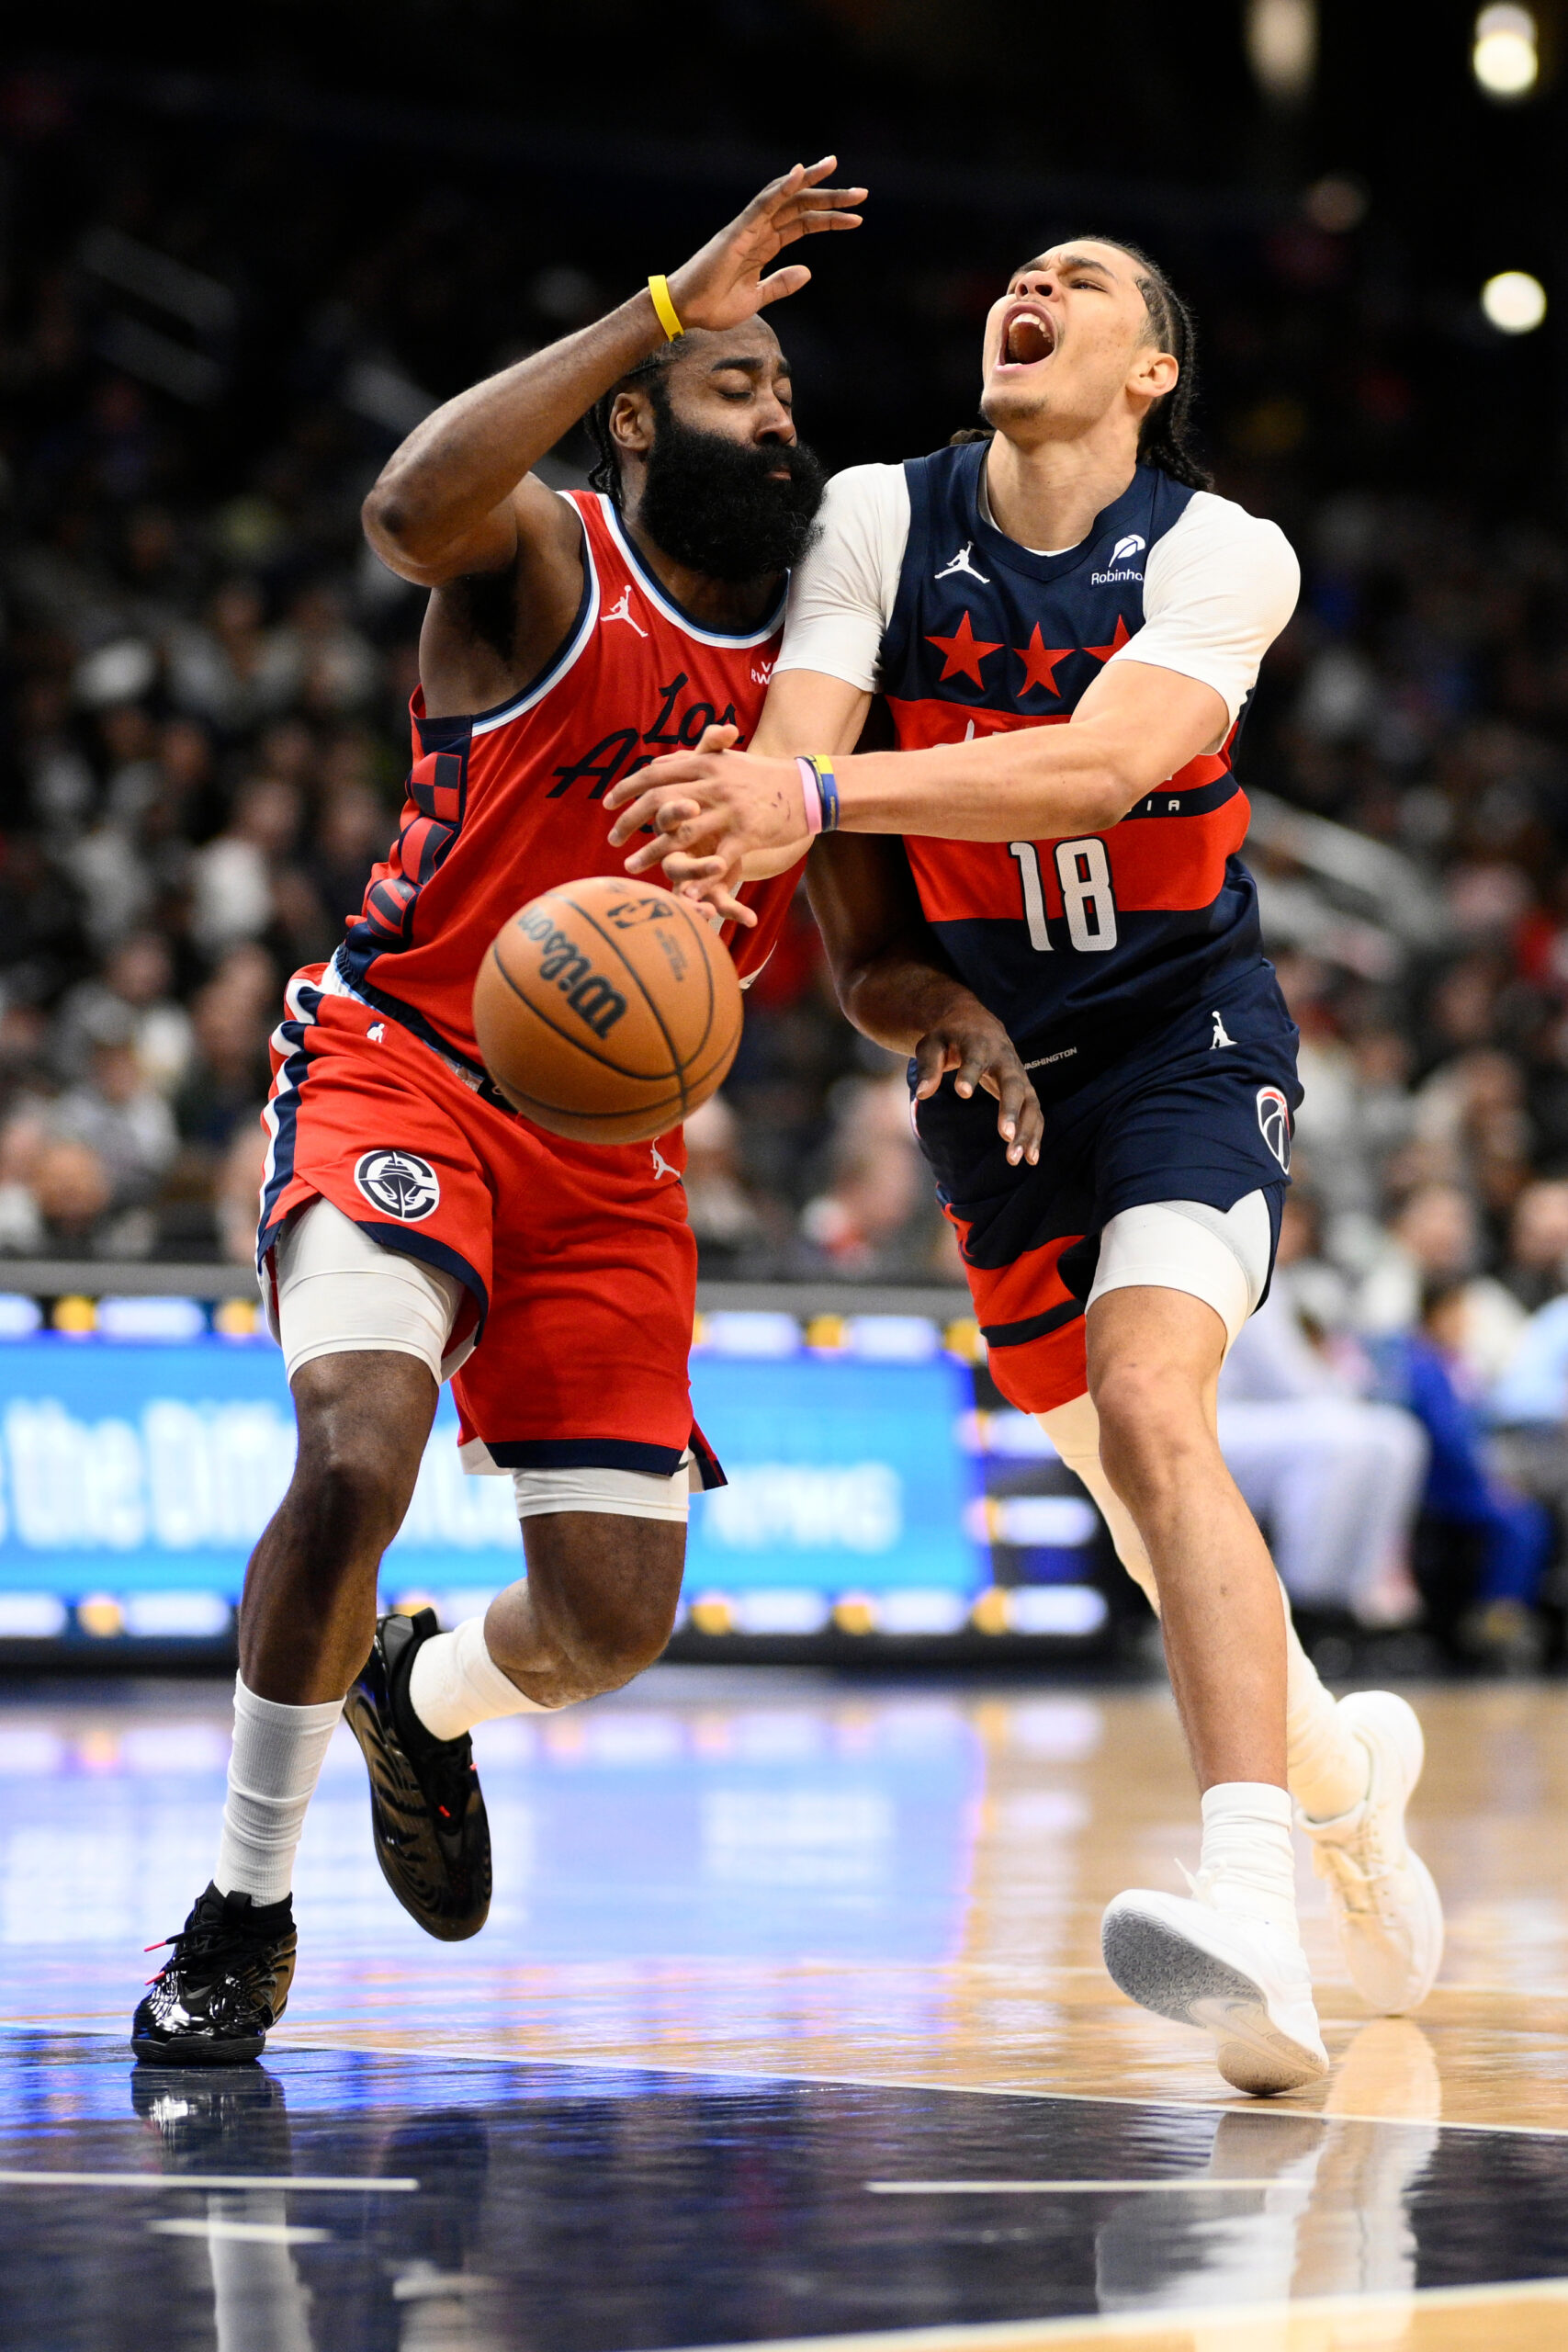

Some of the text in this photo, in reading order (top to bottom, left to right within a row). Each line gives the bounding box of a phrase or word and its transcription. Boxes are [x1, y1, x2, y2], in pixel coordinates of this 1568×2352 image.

[1091, 569, 1145, 585] Robinho
[1010, 838, 1118, 952] 18
[517, 905, 627, 1039] Wilson
